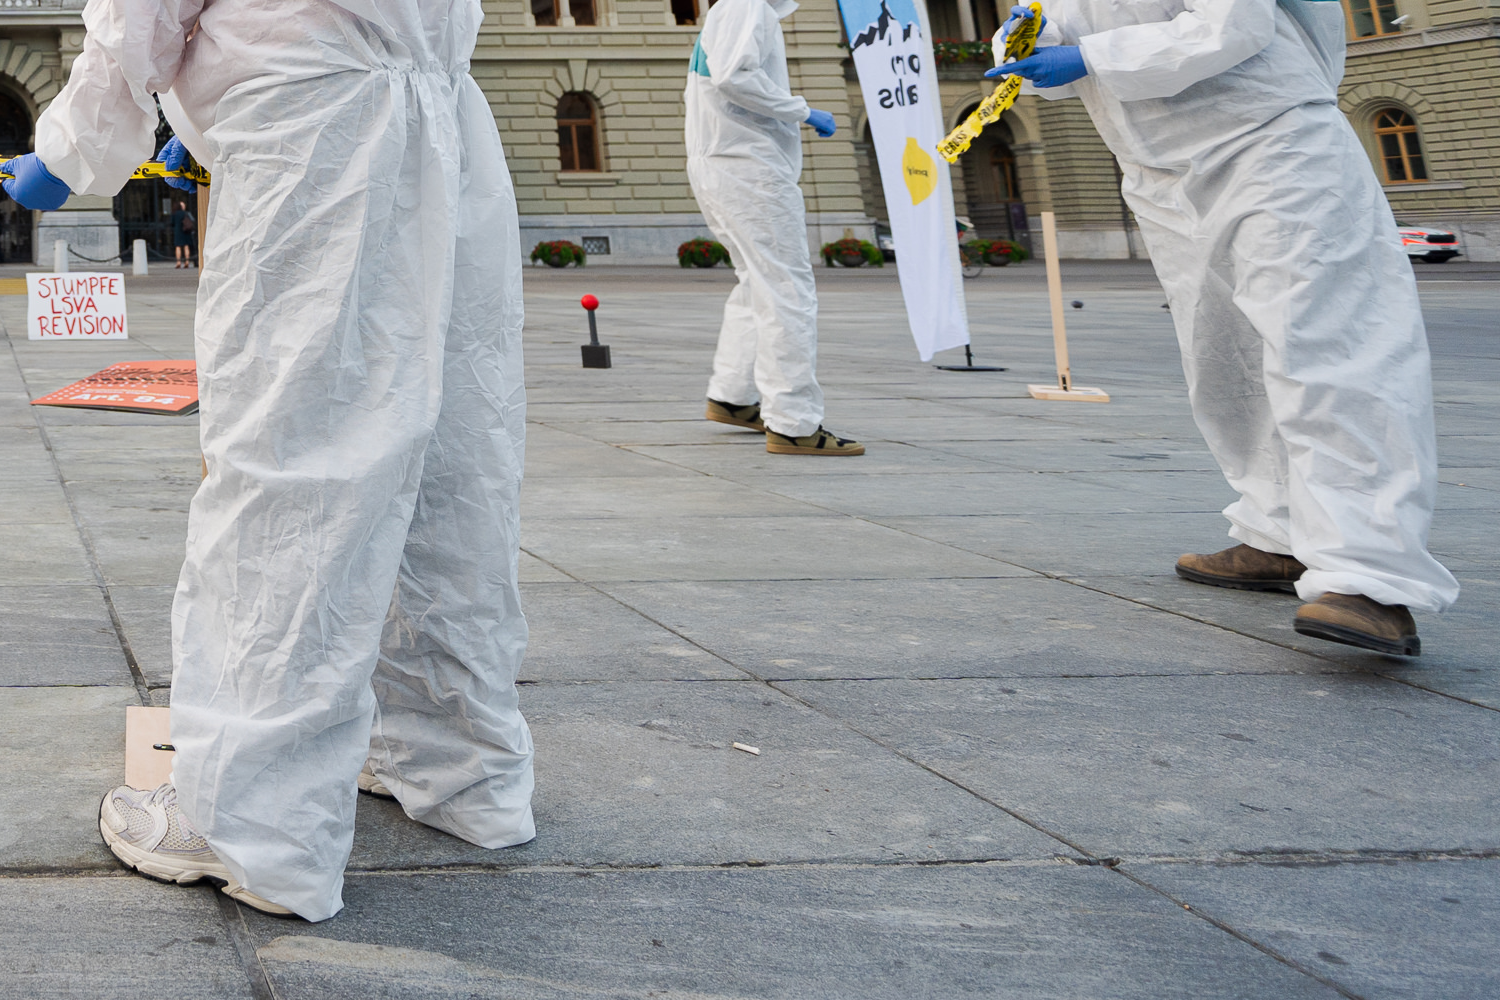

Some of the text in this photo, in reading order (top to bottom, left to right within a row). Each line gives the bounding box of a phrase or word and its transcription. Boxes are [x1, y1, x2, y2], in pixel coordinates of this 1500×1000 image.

[38, 276, 119, 298] STUMPFE
[51, 296, 98, 315] LSVA
[37, 313, 124, 336] REVISION
[70, 393, 125, 402] Art.
[133, 395, 176, 404] 84
